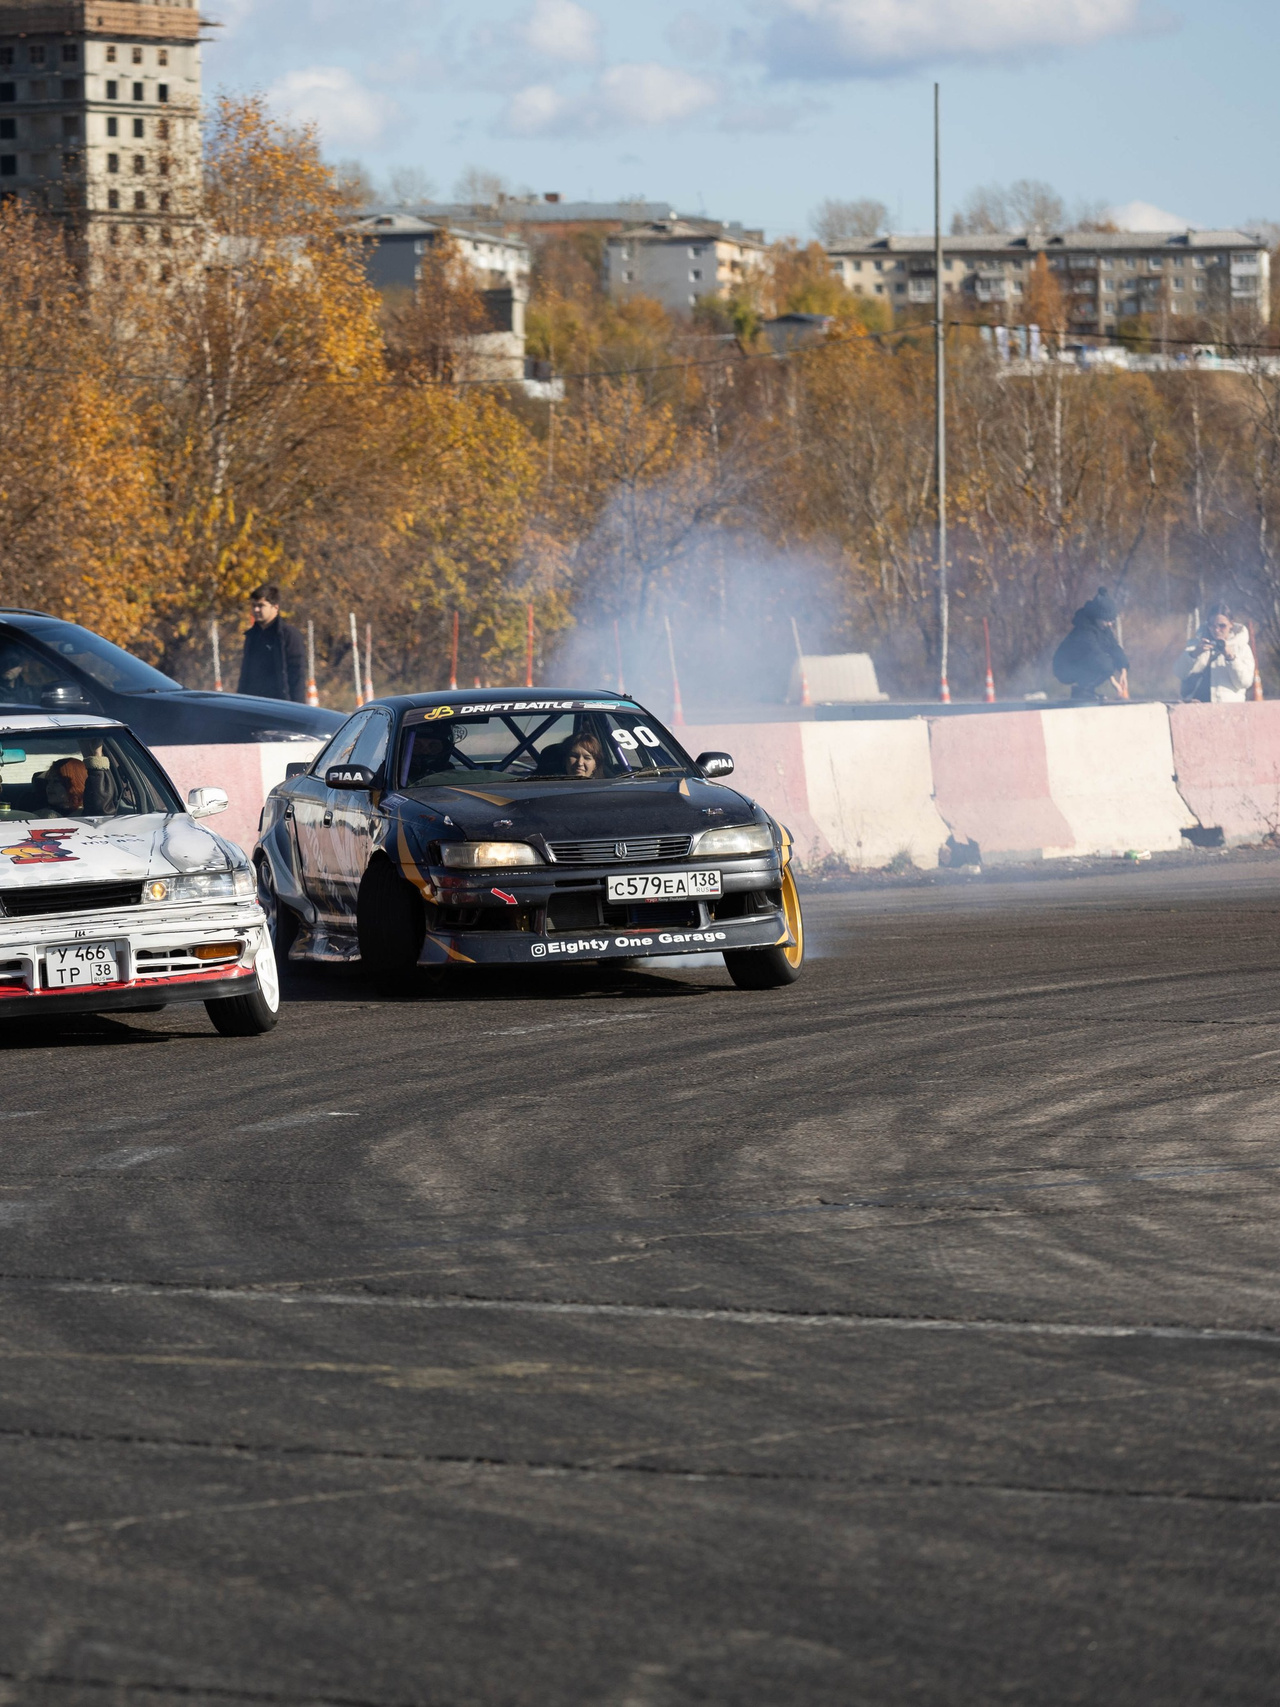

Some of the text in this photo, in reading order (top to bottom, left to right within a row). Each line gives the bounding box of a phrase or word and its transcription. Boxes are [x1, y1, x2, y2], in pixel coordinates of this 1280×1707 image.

[460, 702, 513, 714] DRIFT
[513, 700, 574, 711] BATTLE
[611, 726, 661, 750] 90
[711, 758, 734, 769] PIAA
[329, 772, 364, 781] PIAA
[614, 872, 718, 896] С579ЕА 138
[547, 930, 727, 954] Eighty One Garage
[57, 944, 106, 963] У 466
[56, 963, 112, 984] ТР 38
